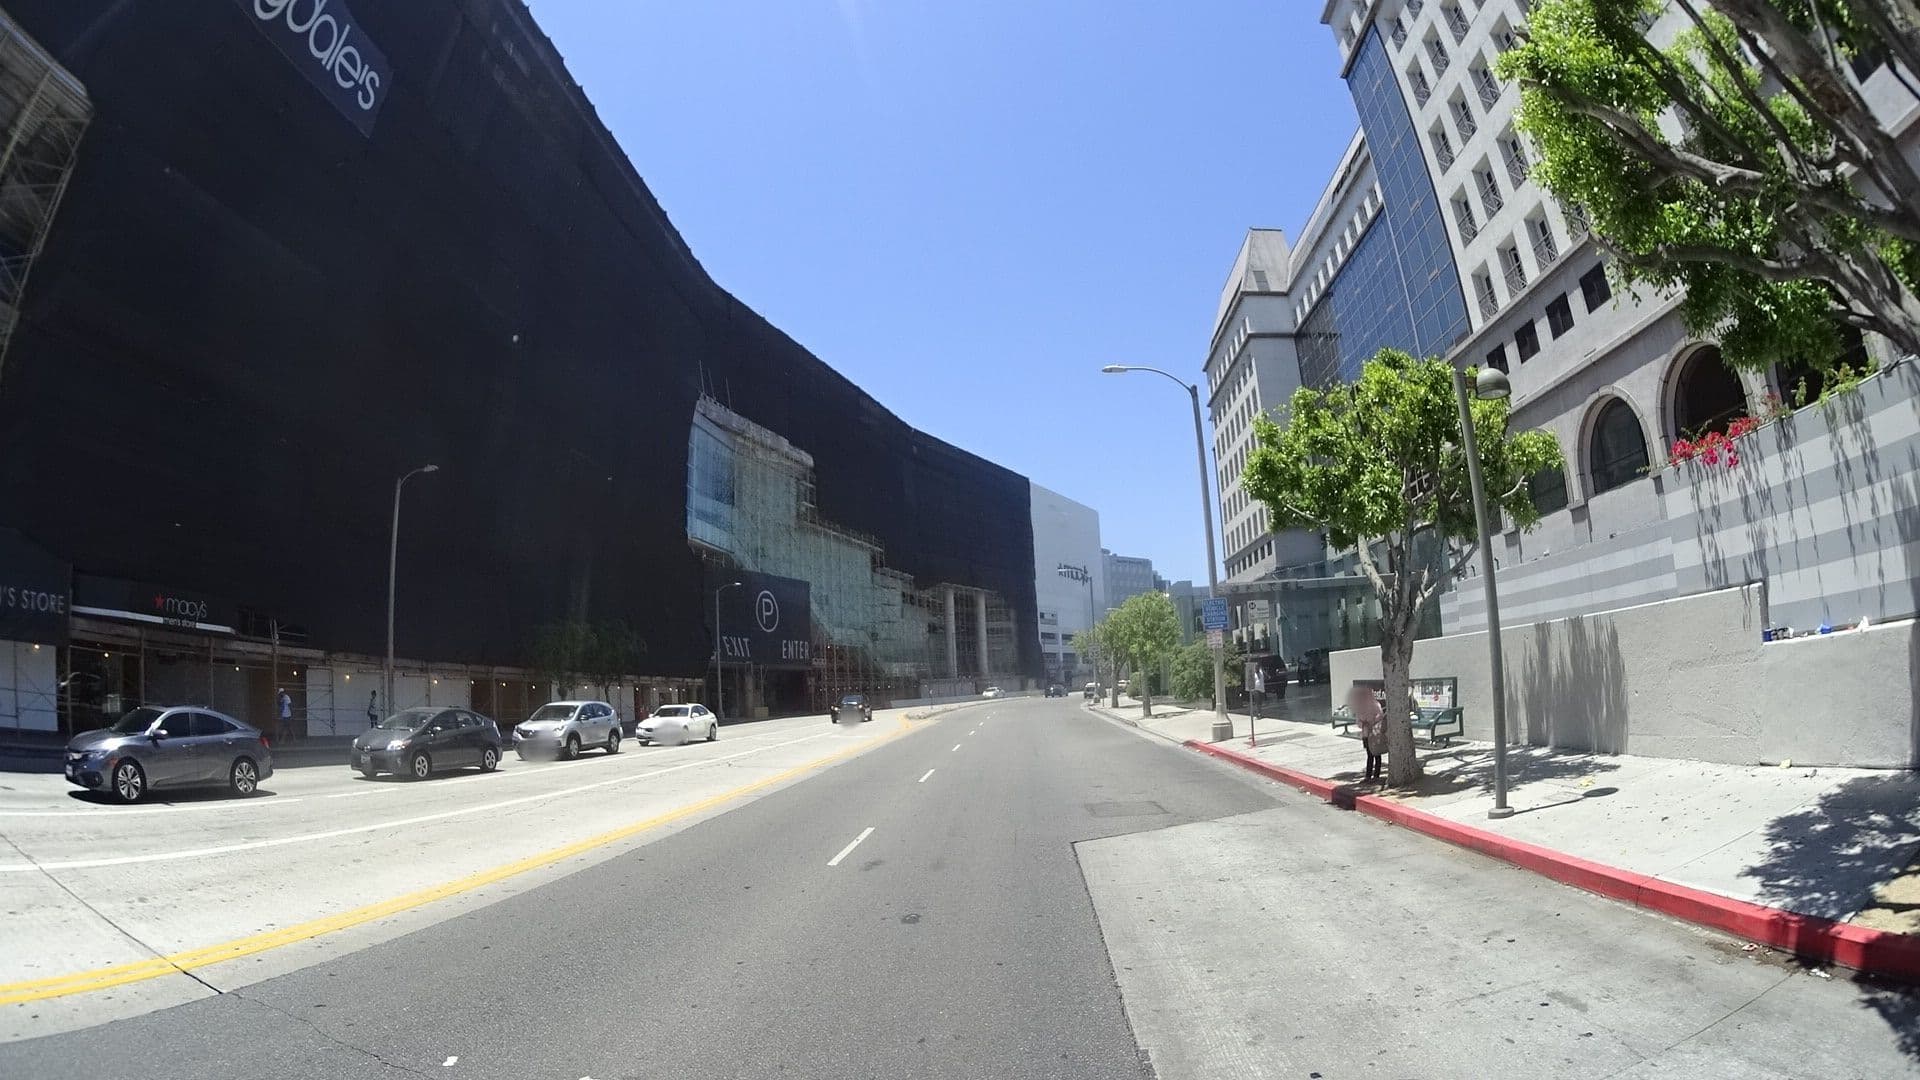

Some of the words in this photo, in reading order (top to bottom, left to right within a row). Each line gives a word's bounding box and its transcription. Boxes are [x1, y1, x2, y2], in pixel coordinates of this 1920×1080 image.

[0, 585, 16, 608] 'S
[21, 589, 65, 615] STORE
[166, 598, 207, 621] macy's
[762, 598, 774, 624] P
[722, 636, 751, 658] EXIT
[782, 639, 810, 660] ENTER
